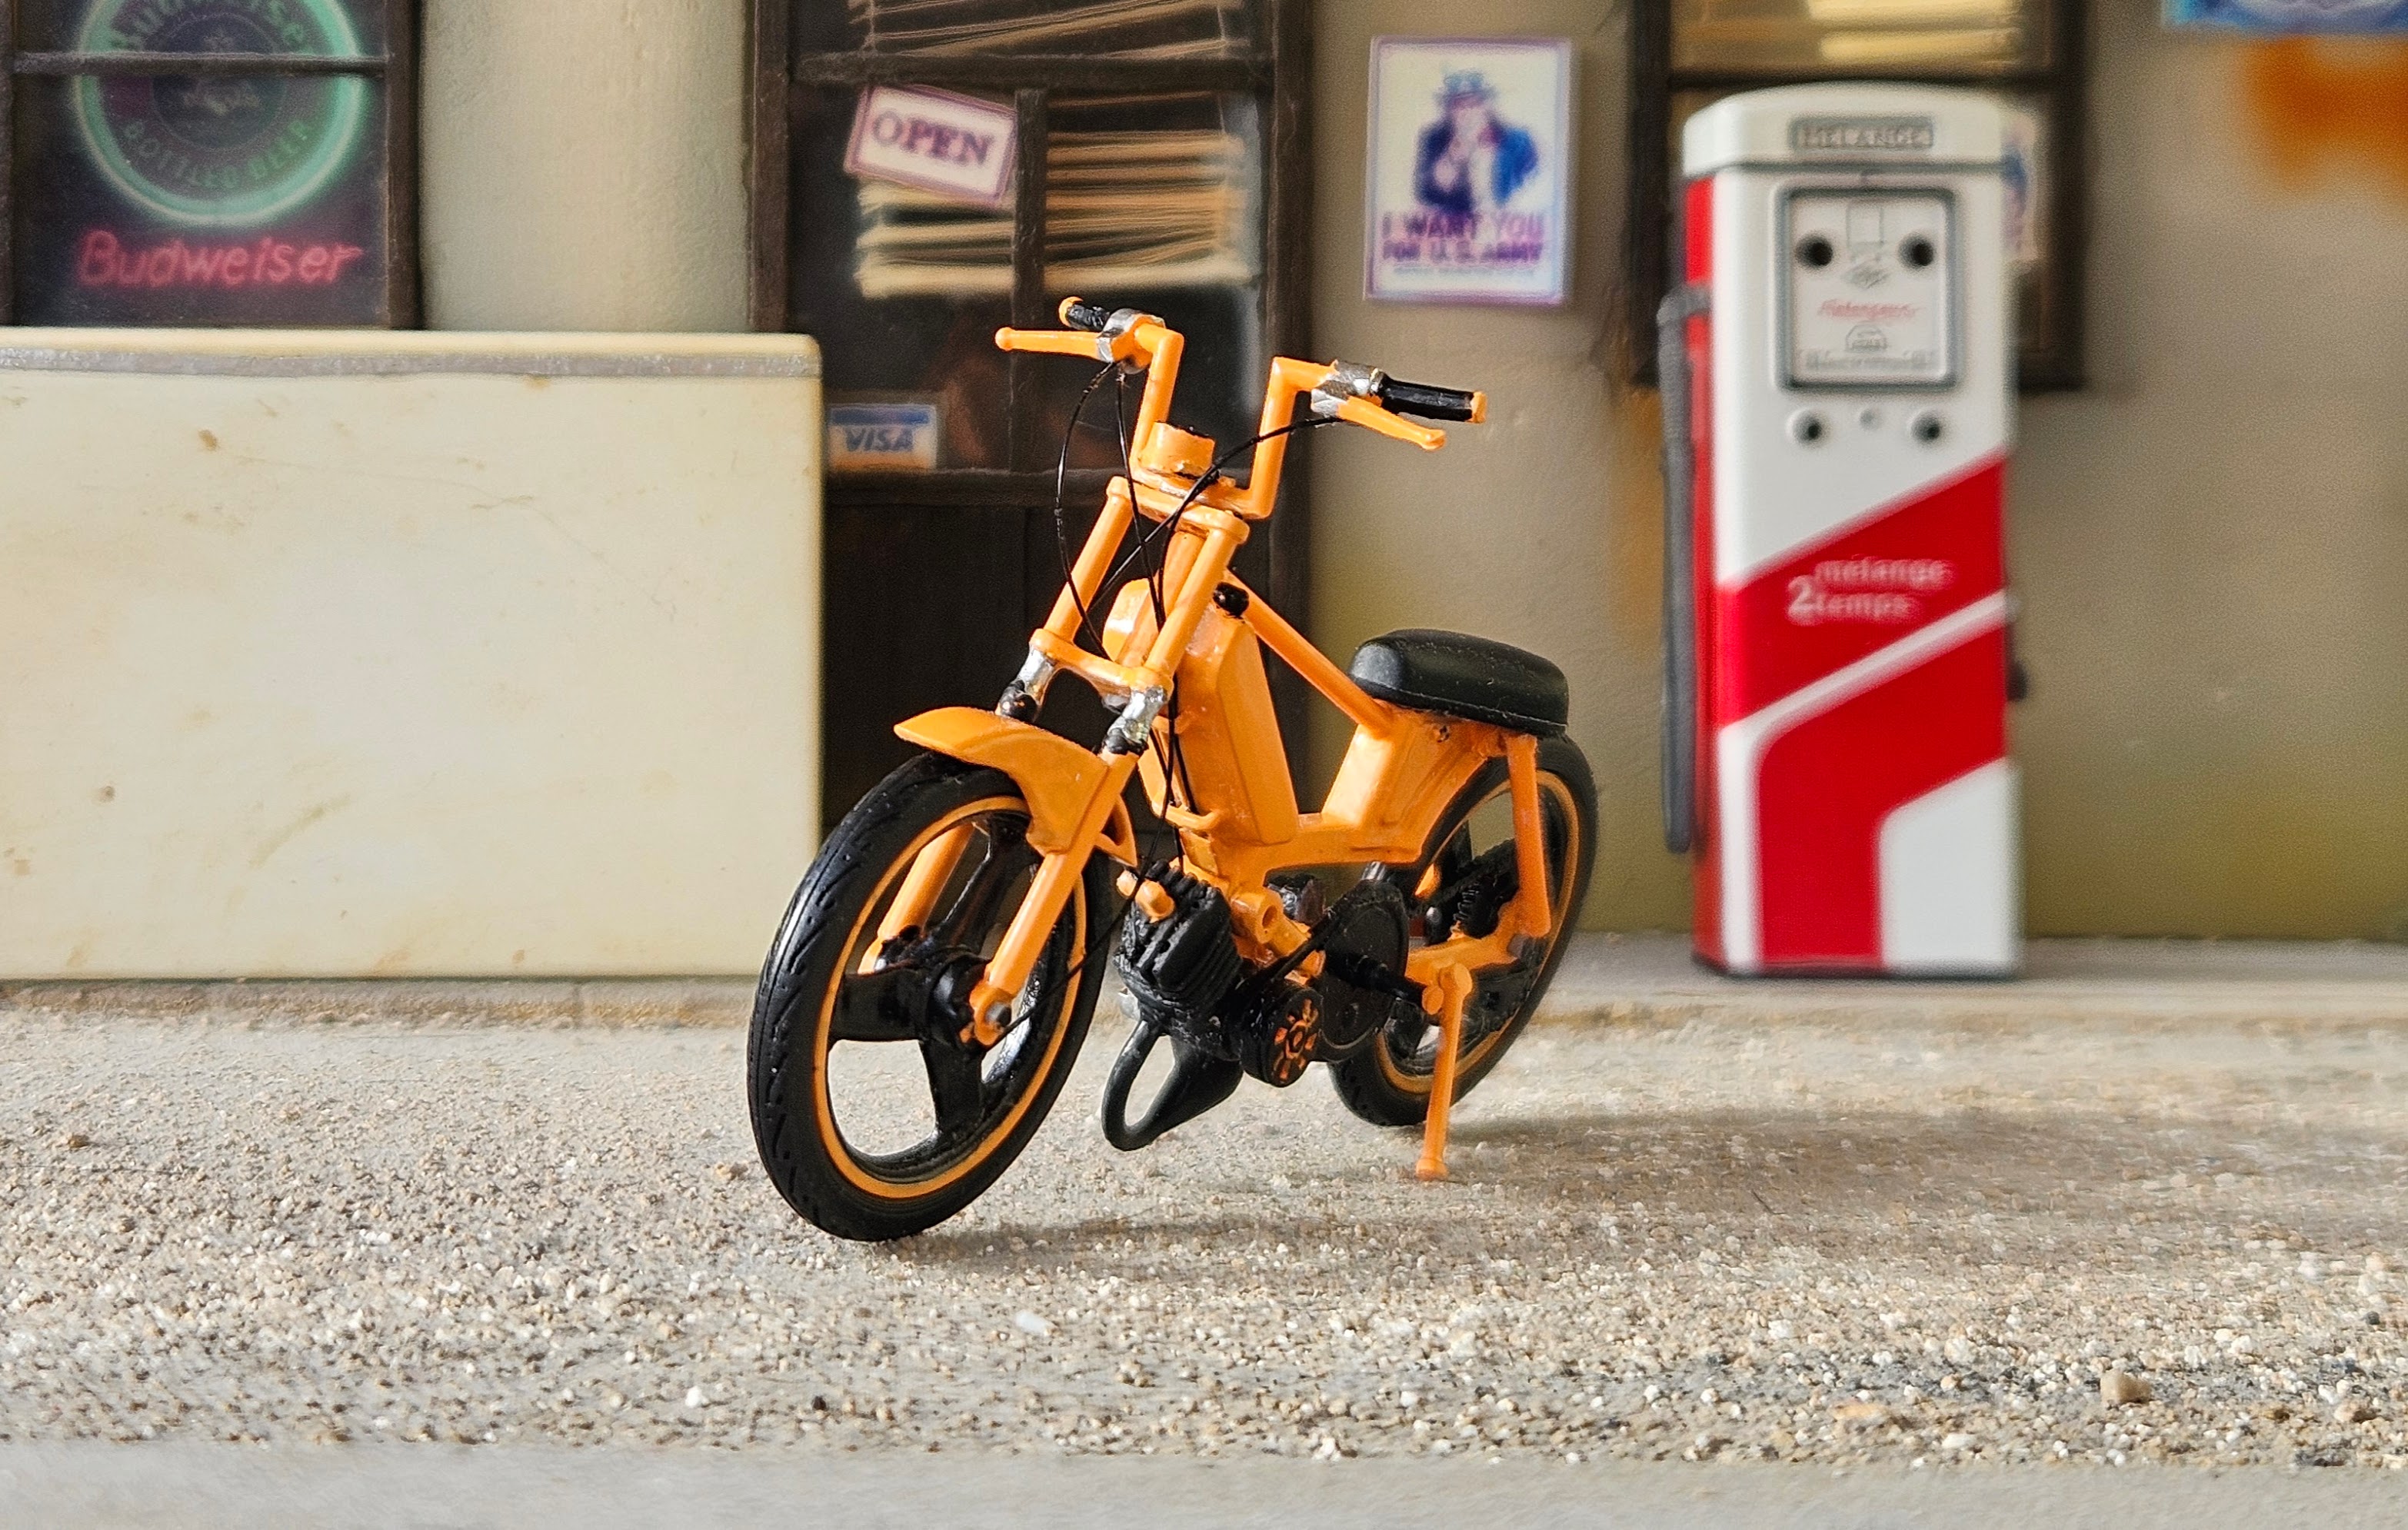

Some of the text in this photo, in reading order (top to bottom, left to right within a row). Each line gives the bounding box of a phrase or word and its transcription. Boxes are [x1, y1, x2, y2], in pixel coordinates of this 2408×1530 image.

[248, 120, 314, 181] BEER
[873, 108, 995, 167] OPEN
[1382, 212, 1545, 240] I WANT YOU
[82, 231, 363, 286] Budweiser
[846, 426, 914, 452] VISA
[1788, 575, 1816, 623] 2
